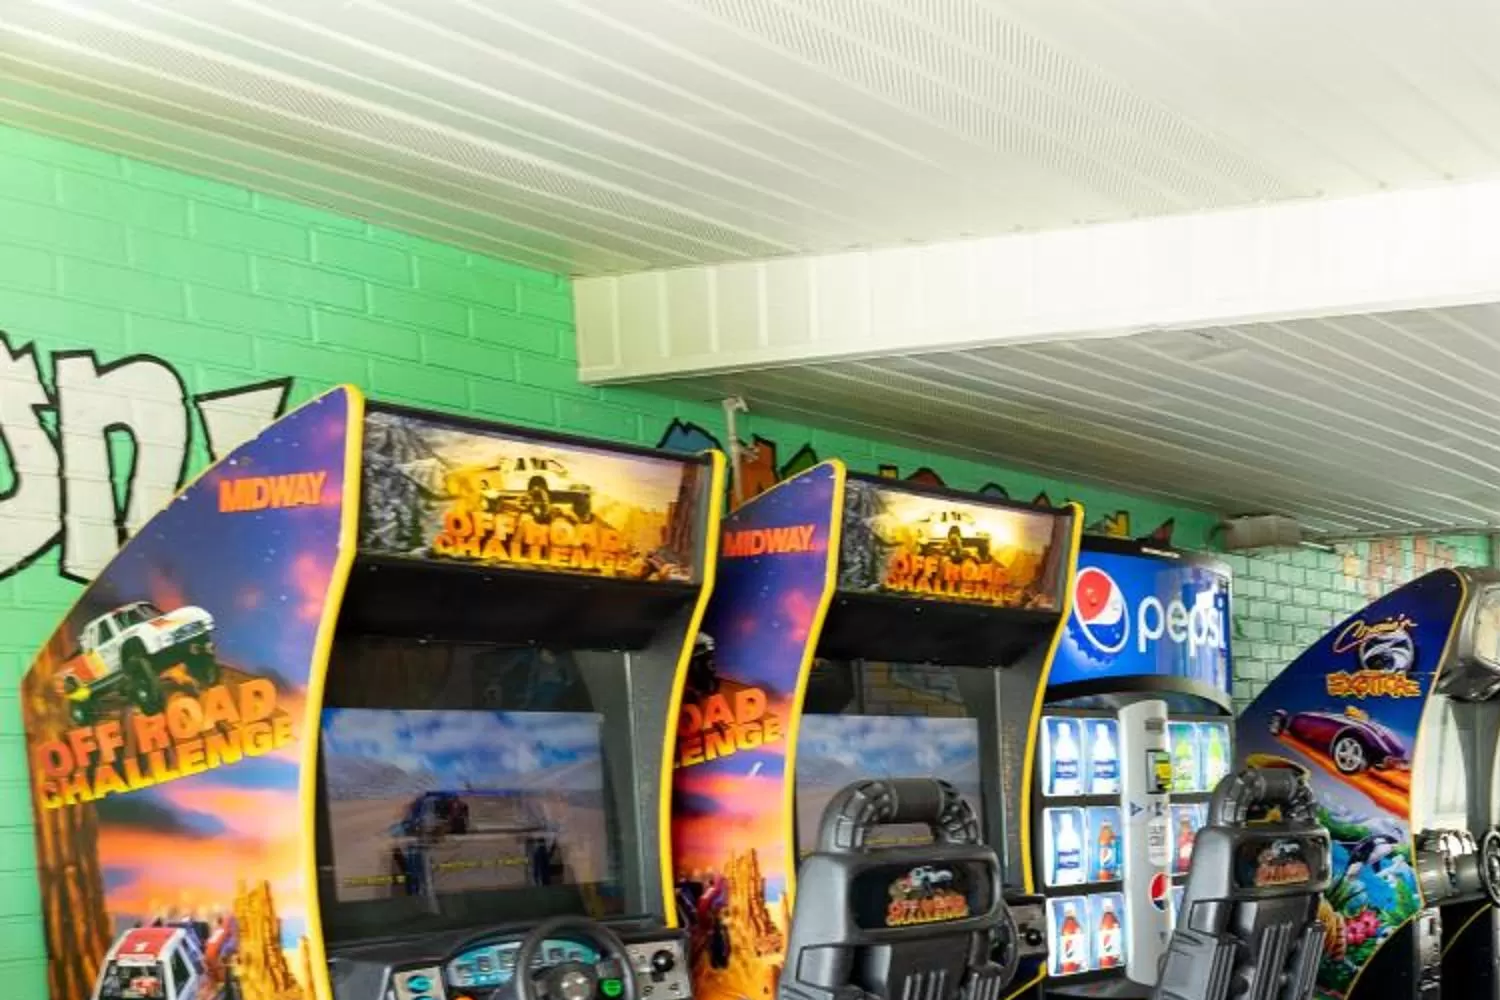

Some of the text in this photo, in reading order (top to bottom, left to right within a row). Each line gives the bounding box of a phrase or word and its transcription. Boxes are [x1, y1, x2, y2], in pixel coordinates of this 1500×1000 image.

[218, 471, 327, 513] MIDWAY
[445, 510, 620, 551] OFF ROAD
[723, 524, 817, 557] MIDWAY
[1137, 595, 1227, 658] pepsi
[38, 679, 278, 778] OFF ROAD
[680, 688, 768, 736] OAD
[39, 716, 298, 809] CHALLENGE
